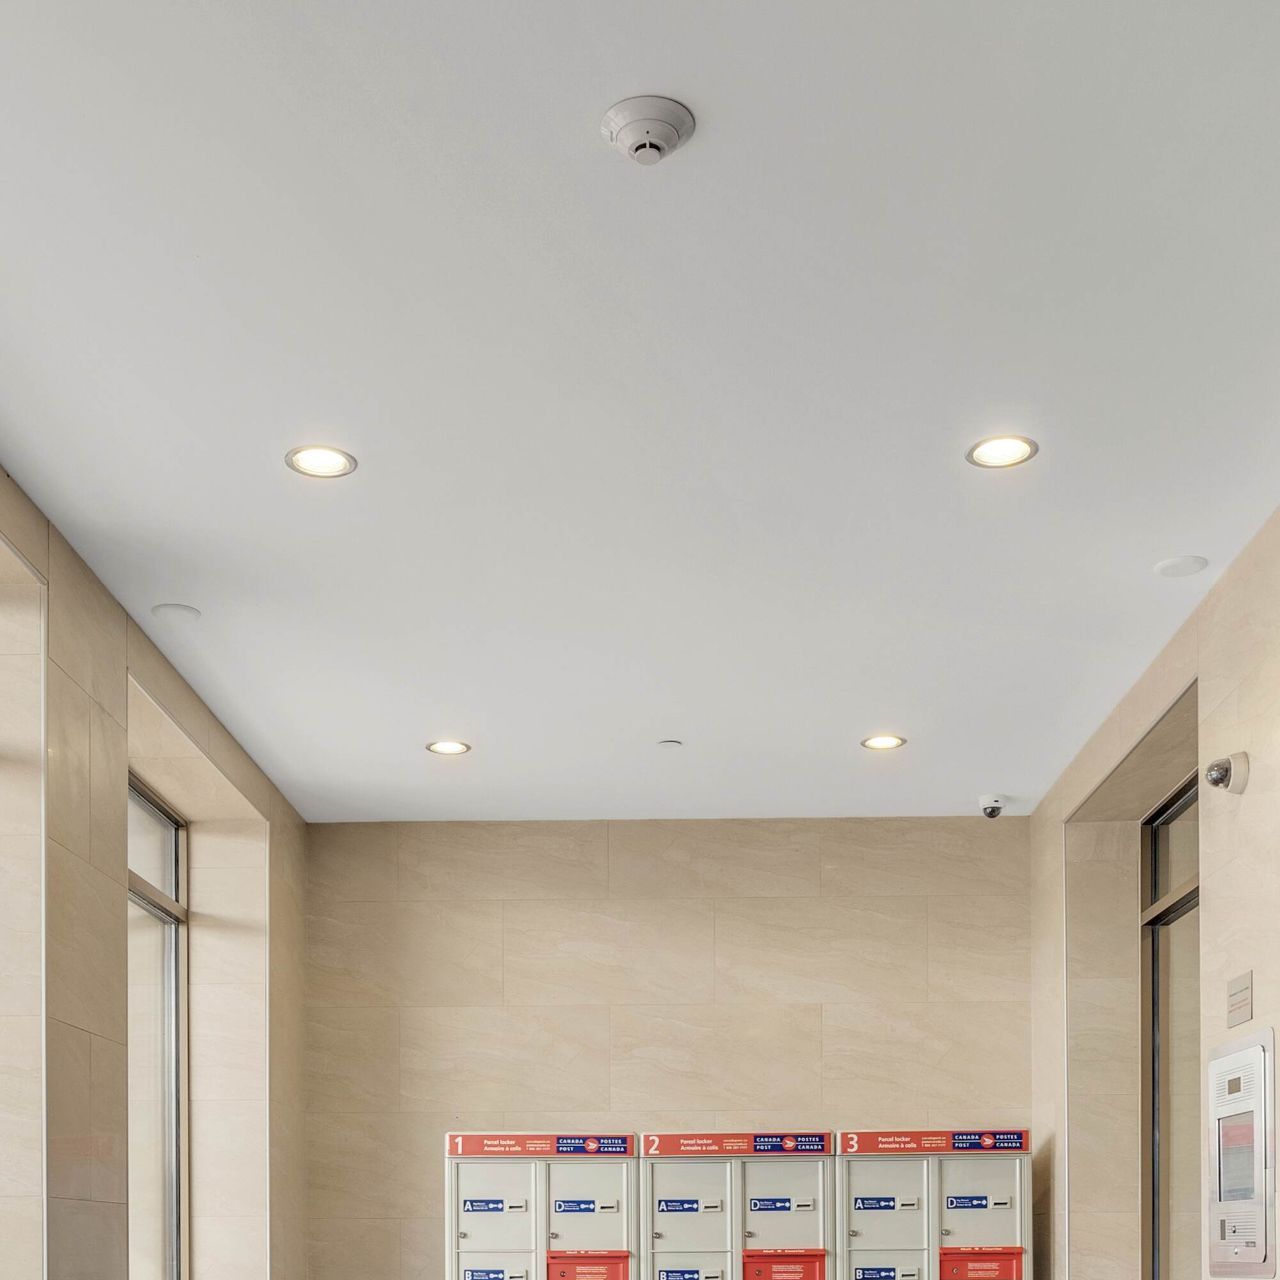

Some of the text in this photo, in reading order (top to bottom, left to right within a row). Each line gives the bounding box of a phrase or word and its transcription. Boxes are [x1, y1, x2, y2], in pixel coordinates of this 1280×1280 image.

[455, 1136, 462, 1154] 1
[649, 1136, 659, 1154] 2
[847, 1134, 858, 1152] 3
[464, 1201, 472, 1211] A
[556, 1202, 564, 1211] D
[659, 1201, 667, 1211] A
[751, 1200, 760, 1210] D
[855, 1199, 863, 1209] A
[948, 1198, 956, 1207] D
[466, 1271, 472, 1280] B
[660, 1271, 667, 1280] B
[856, 1270, 863, 1279] B
